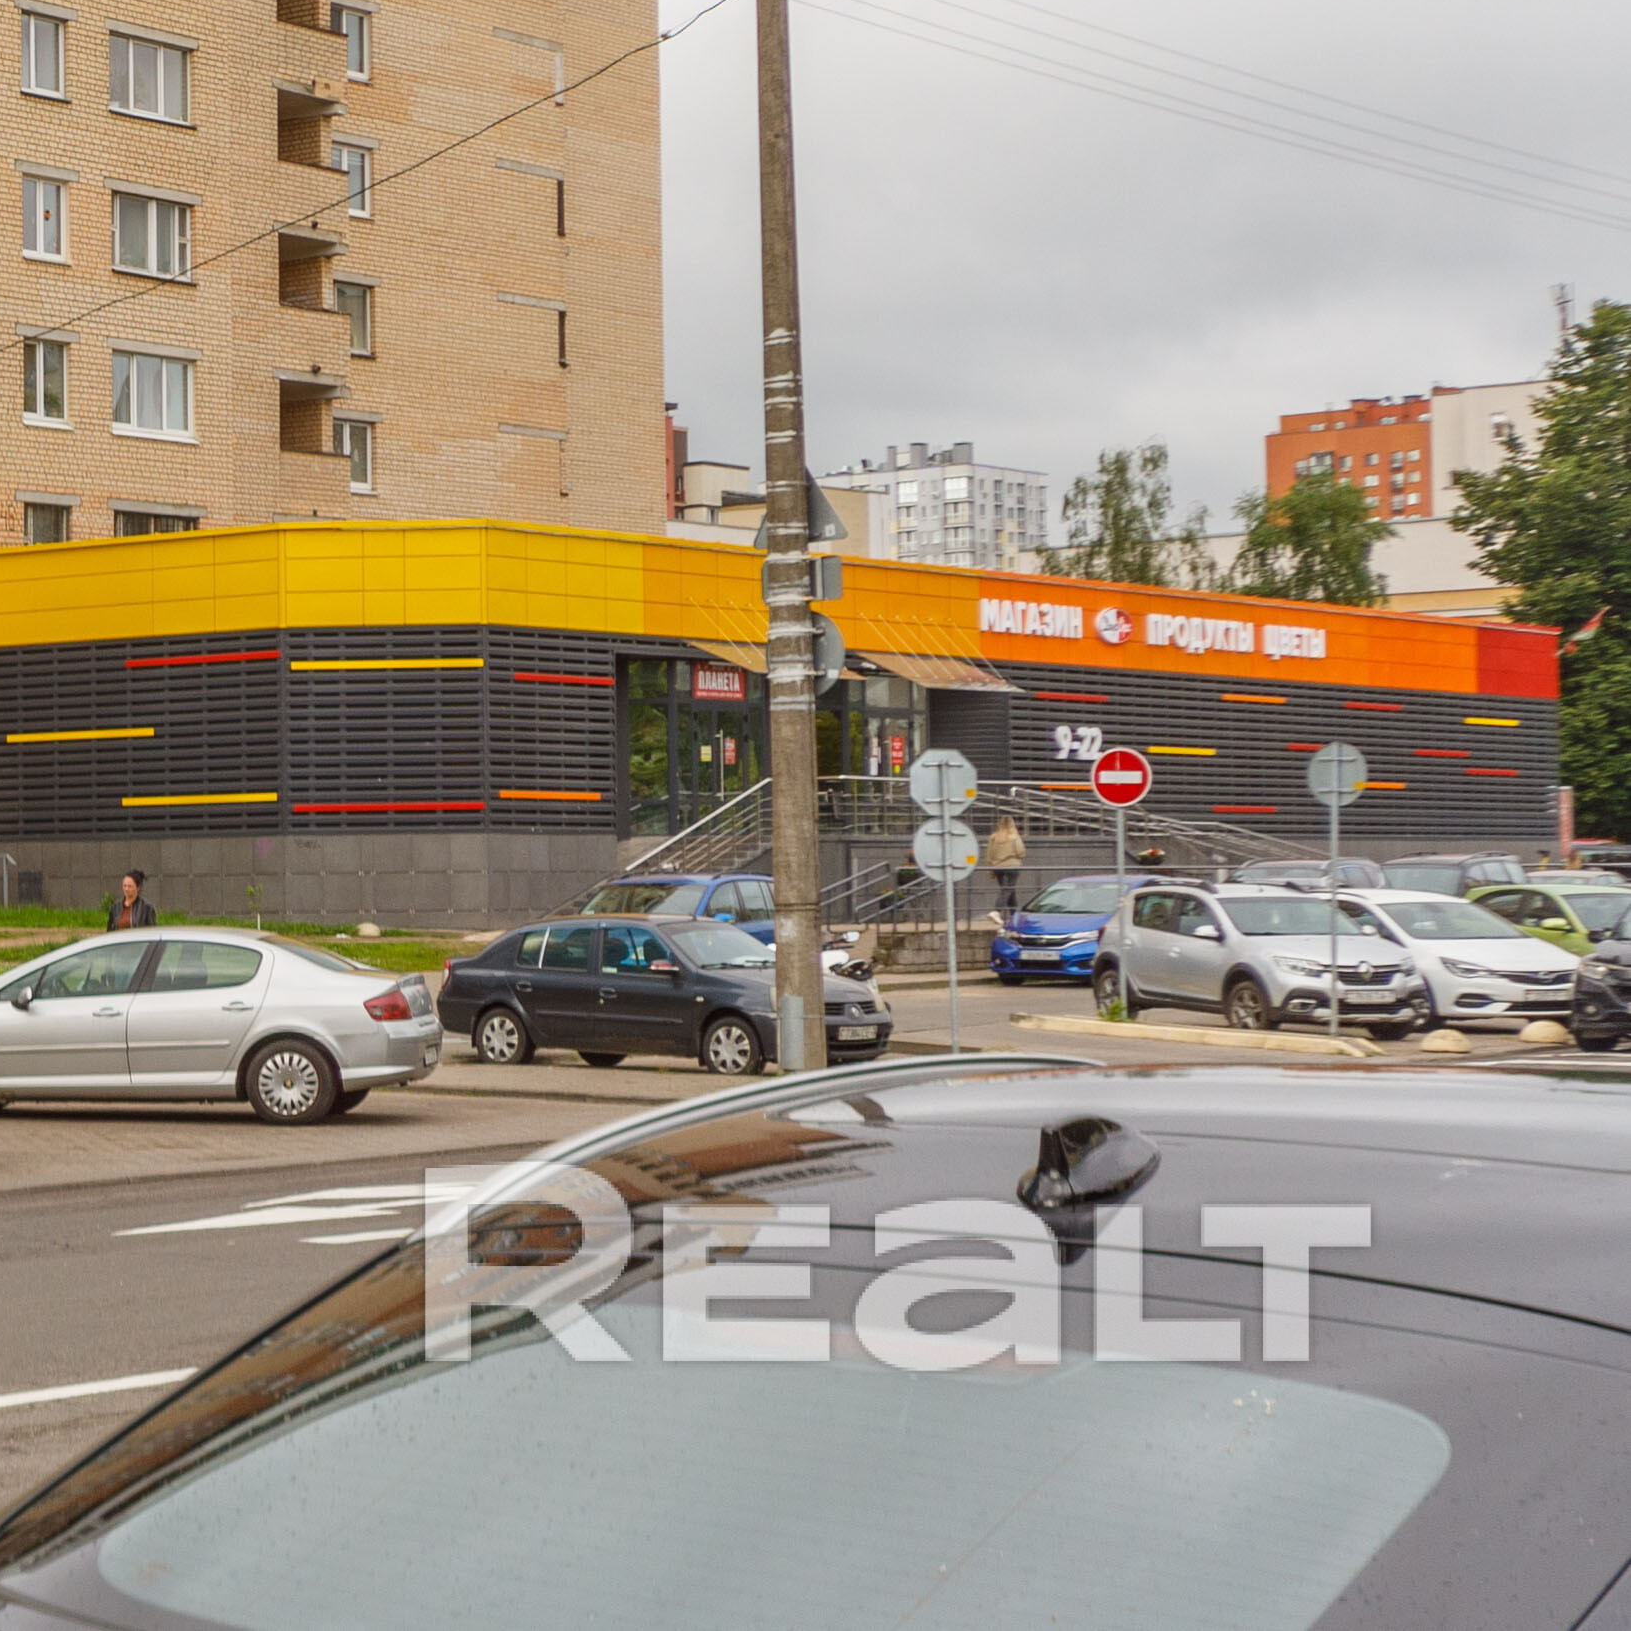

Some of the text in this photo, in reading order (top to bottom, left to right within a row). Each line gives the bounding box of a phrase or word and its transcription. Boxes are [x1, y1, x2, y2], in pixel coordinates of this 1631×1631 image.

[979, 597, 1083, 639] МАГАЗИН
[1145, 613, 1255, 654] ПРОДУКТЫ
[1262, 624, 1327, 660] ЦВЕТЫ
[1055, 725, 1103, 760] 9-22
